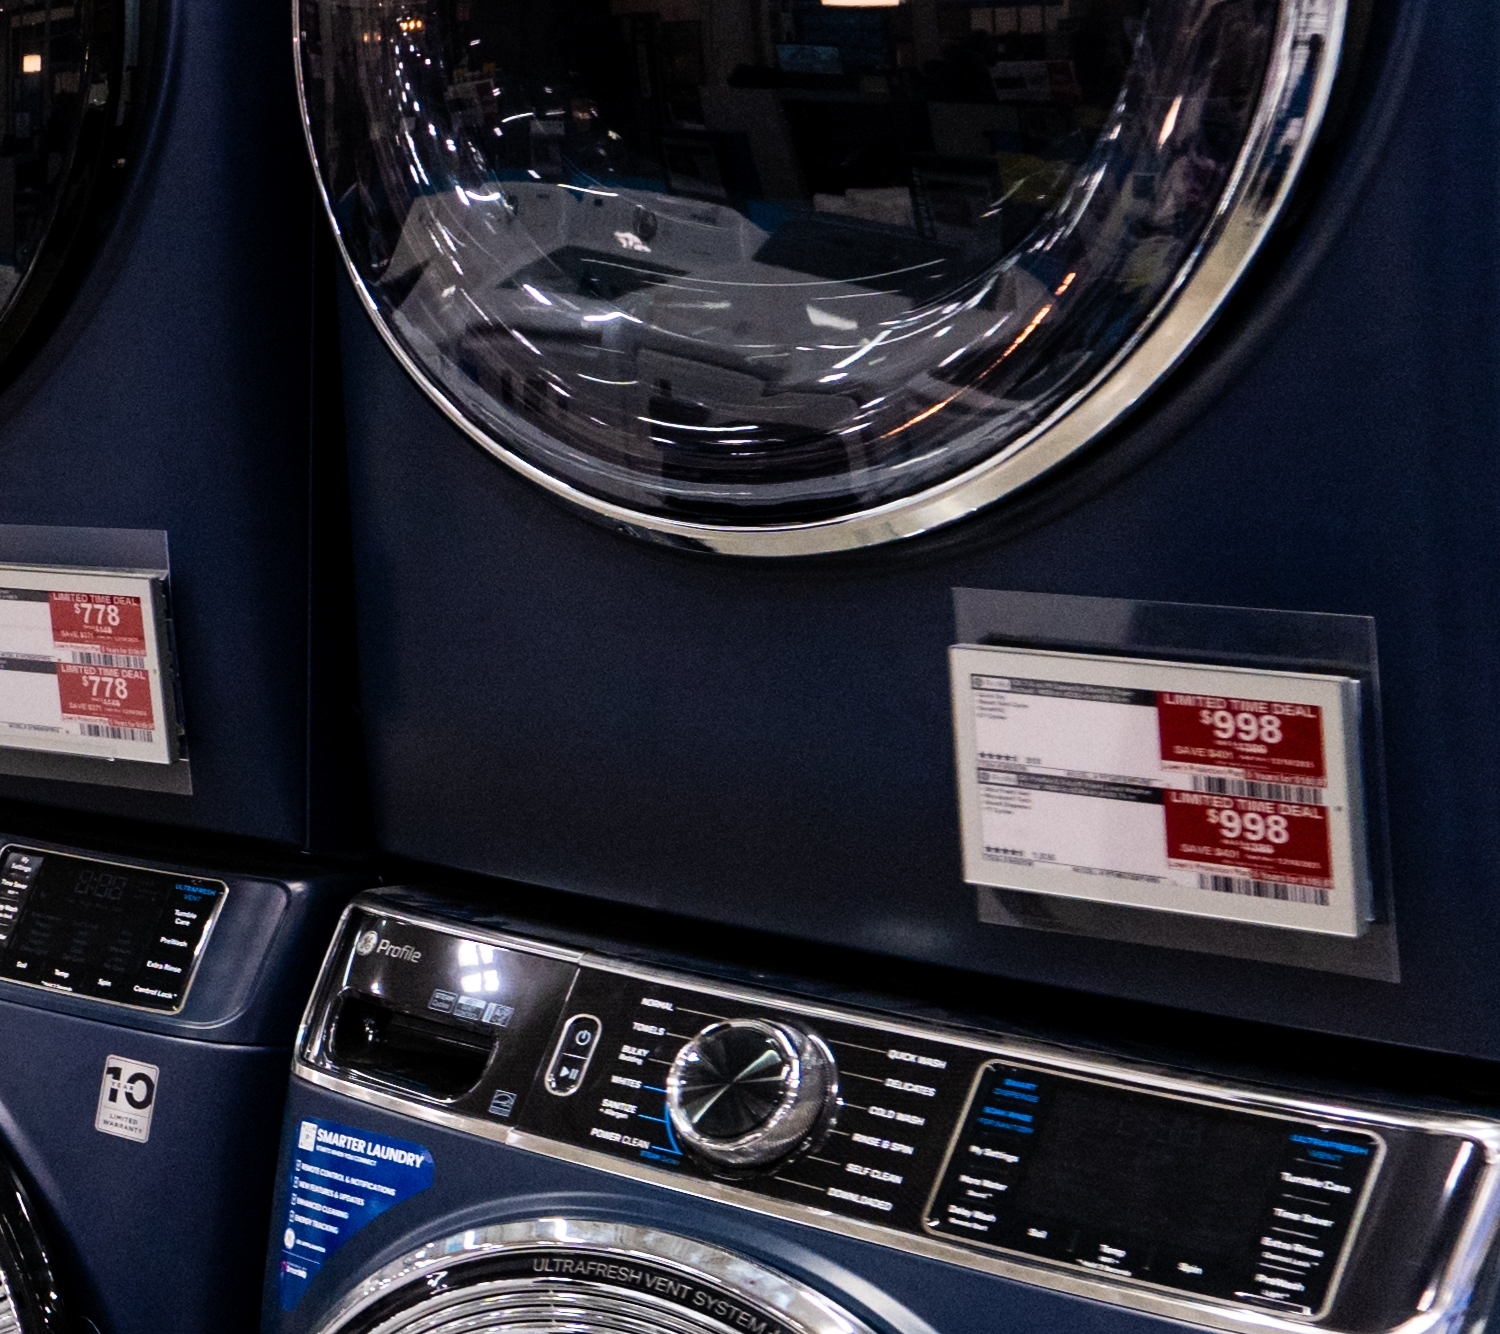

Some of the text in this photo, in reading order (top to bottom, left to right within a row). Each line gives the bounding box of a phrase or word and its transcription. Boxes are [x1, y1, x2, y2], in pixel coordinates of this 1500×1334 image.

[52, 592, 138, 605] LIMITED TIME DEAL
[74, 603, 120, 626] $778
[60, 664, 146, 680] LIMITED TIME DEAL
[82, 676, 128, 699] $778
[1163, 692, 1317, 719] LIMITED TIME DEAL
[1200, 709, 1283, 745] $998
[1170, 792, 1324, 819] LIMITED TIME DEAL
[1206, 809, 1290, 845] $998
[376, 937, 423, 966] Profile
[133, 985, 174, 999] Control Lock
[887, 1049, 947, 1069] QUICK WASH
[106, 1066, 155, 1110] 10
[884, 1078, 937, 1097] DELICATES
[103, 1119, 143, 1135] WARRANTY
[109, 1113, 139, 1126] LIMITED
[868, 1106, 926, 1126] COLD WASH
[317, 1129, 424, 1168] SMARTER LAUNDRY
[590, 1128, 650, 1149] POWER CLEAN
[846, 1163, 903, 1184] SELF CLEAN
[533, 1258, 643, 1285] ULTRAFRESH
[643, 1272, 693, 1301] VENT
